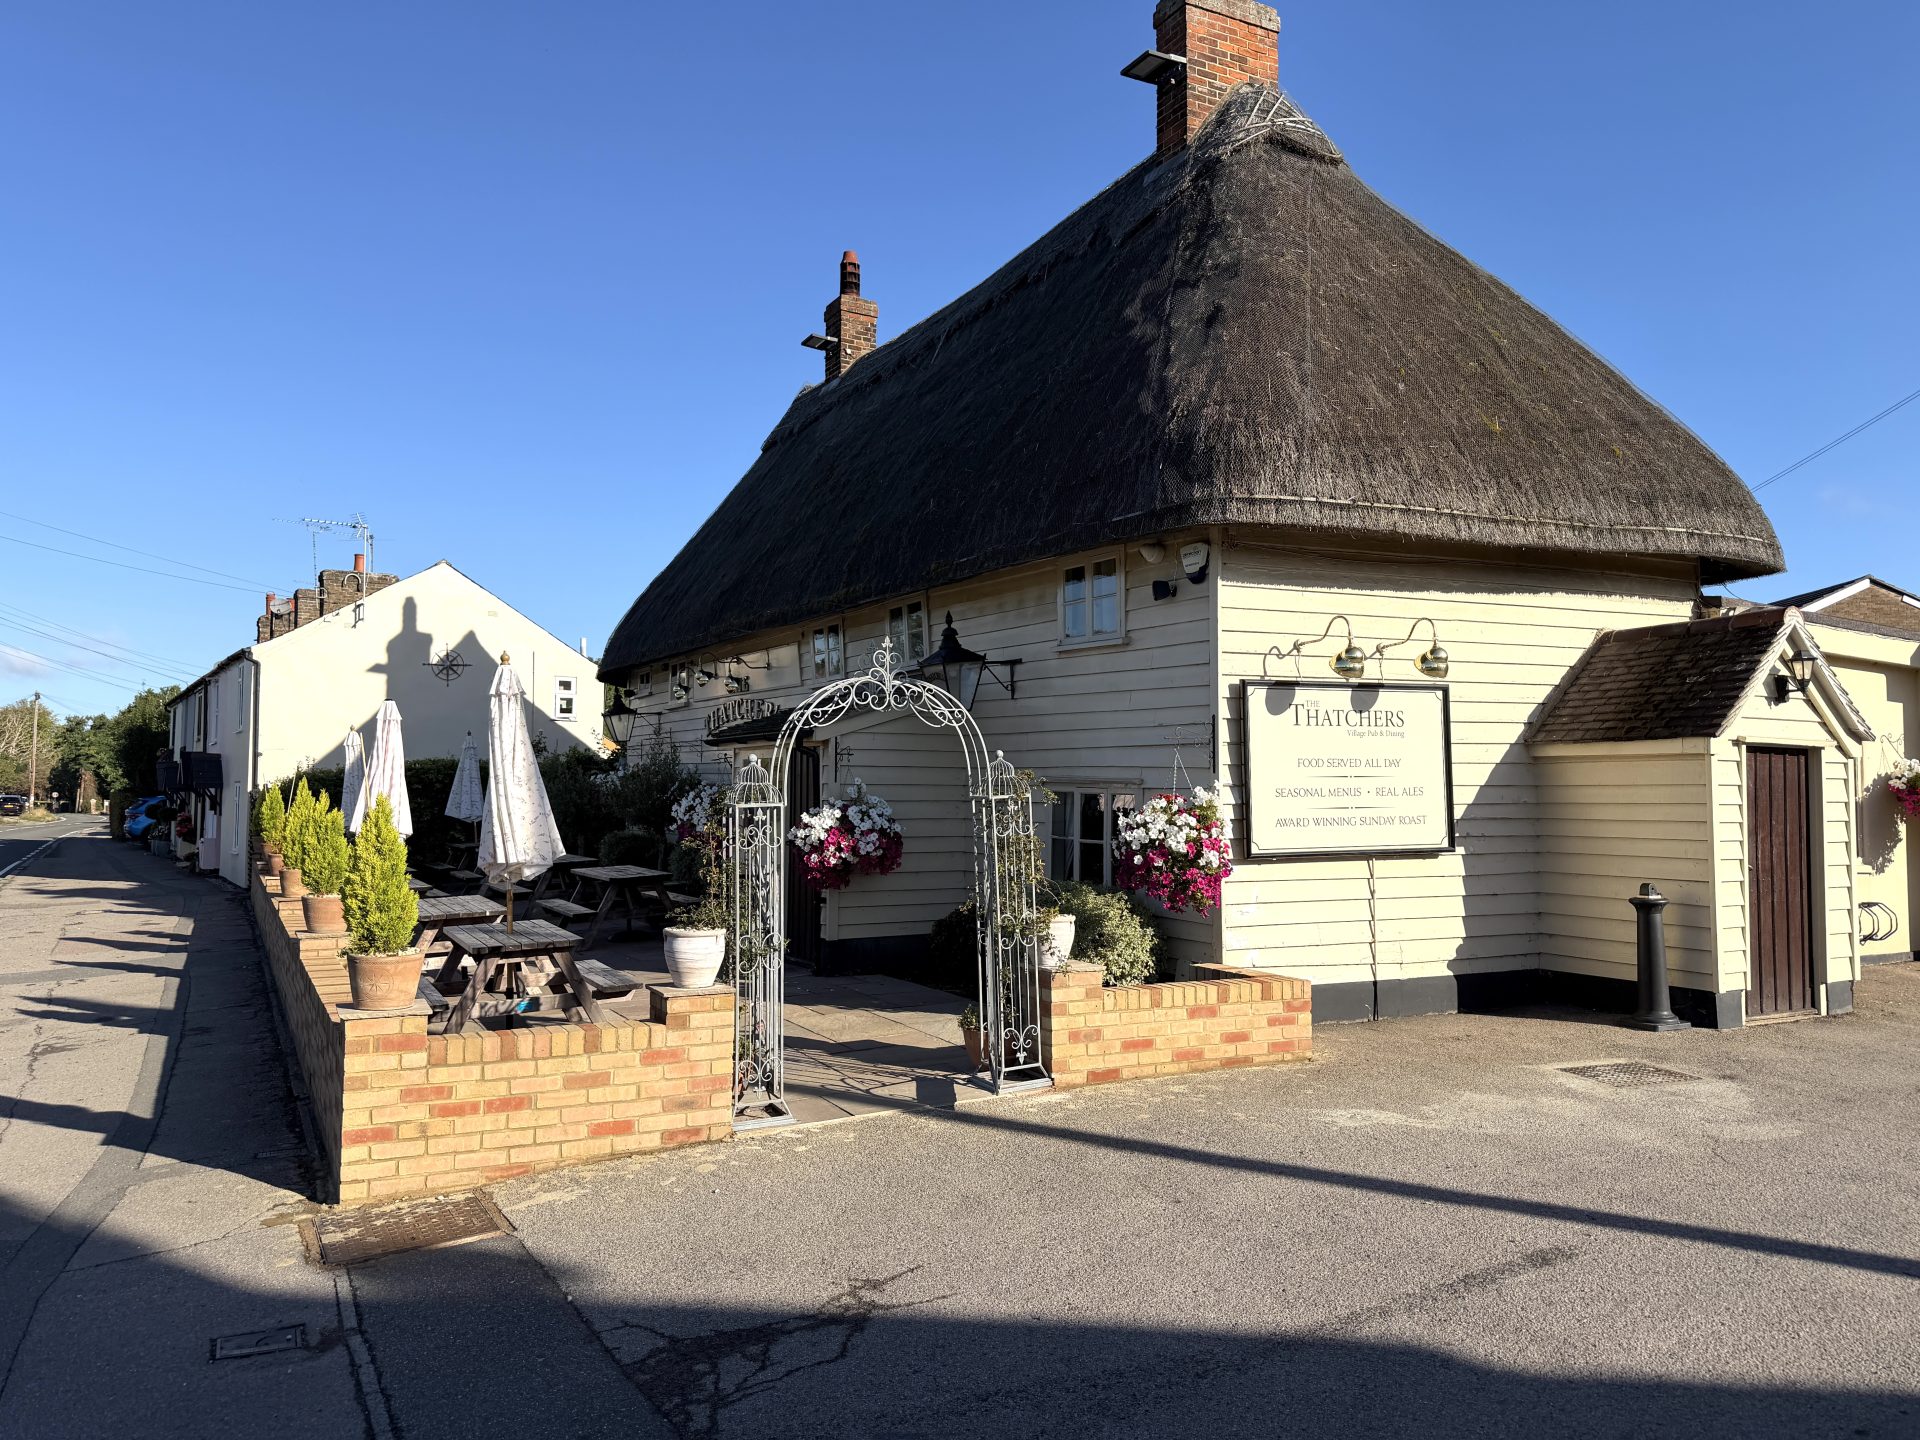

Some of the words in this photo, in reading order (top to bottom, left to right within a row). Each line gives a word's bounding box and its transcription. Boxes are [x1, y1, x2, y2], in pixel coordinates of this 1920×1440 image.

[1306, 700, 1321, 708] THE
[1288, 703, 1405, 728] THATCHERS
[1347, 730, 1367, 739] Village
[1385, 730, 1405, 739] Dining
[1297, 758, 1325, 768] FOOD
[1326, 758, 1362, 768] SERVED
[1364, 758, 1382, 768] ALL
[1384, 758, 1402, 768] DAY
[1275, 787, 1326, 798] SEASONAL
[1328, 787, 1362, 797] MENUS
[1375, 787, 1399, 797] REAL
[1401, 786, 1424, 797] ALES
[1275, 817, 1310, 828] AWARD
[1312, 816, 1357, 827] WINNING
[1359, 815, 1396, 826] SUNDAY
[1399, 815, 1427, 825] ROAST
